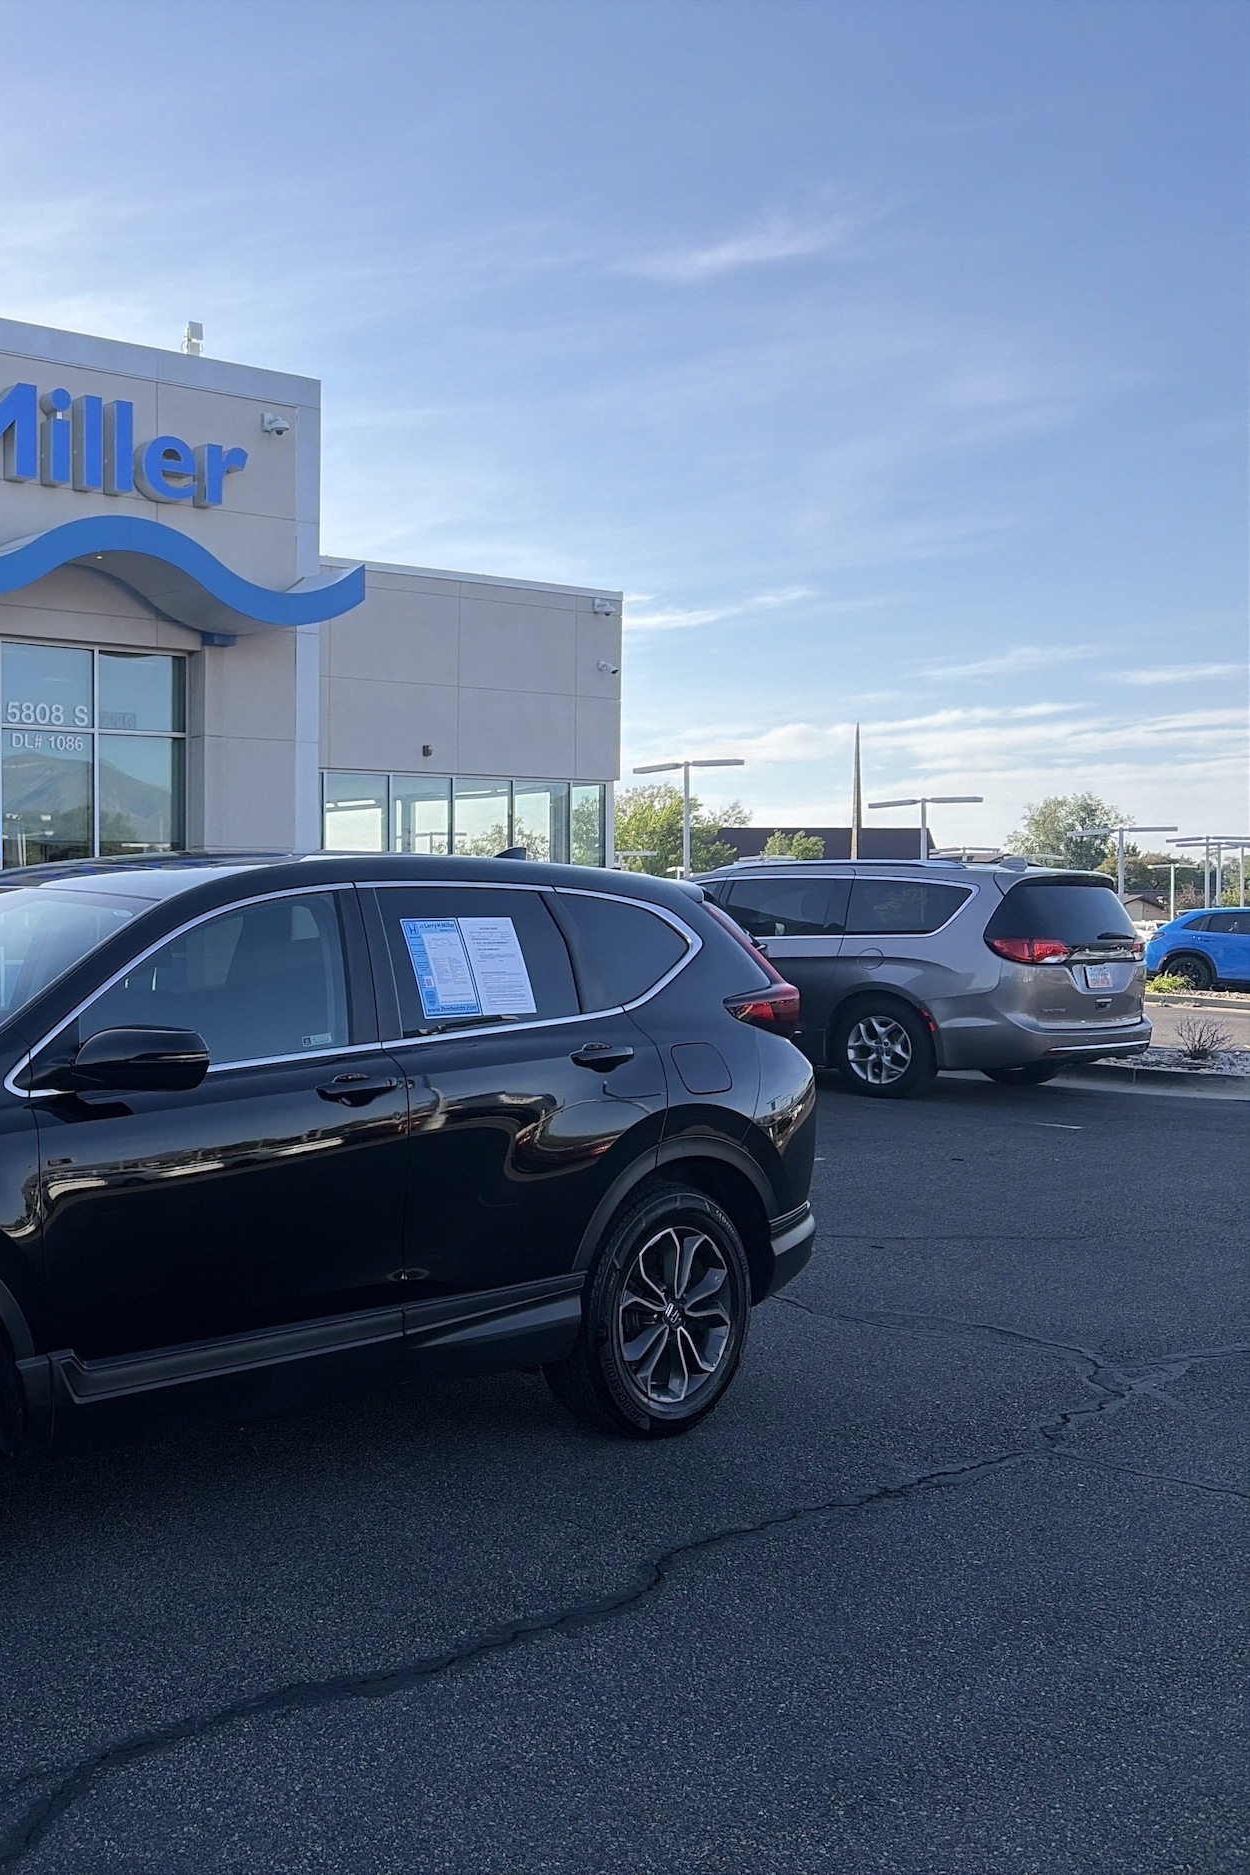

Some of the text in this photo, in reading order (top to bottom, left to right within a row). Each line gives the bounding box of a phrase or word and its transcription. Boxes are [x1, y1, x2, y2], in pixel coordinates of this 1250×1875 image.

[6, 702, 65, 726] 5808
[74, 705, 89, 727] S
[11, 733, 84, 751] DL# 1086
